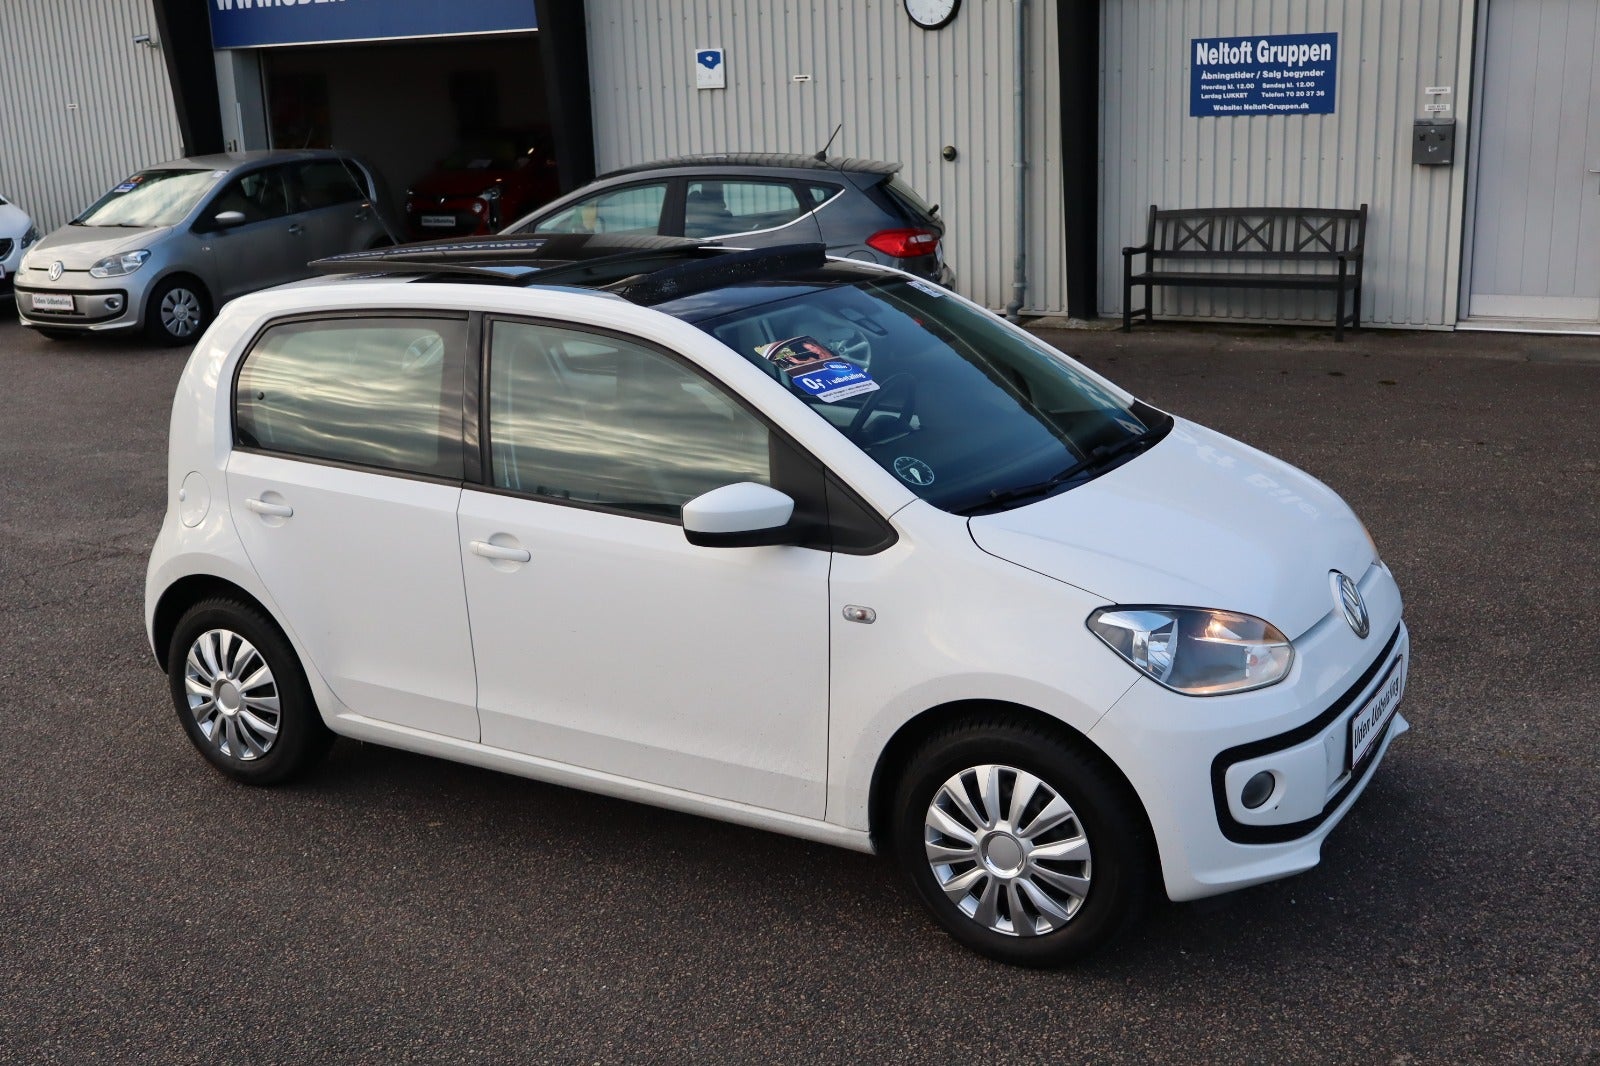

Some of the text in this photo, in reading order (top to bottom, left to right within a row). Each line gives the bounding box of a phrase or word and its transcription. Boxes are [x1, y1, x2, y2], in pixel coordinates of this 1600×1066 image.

[1196, 40, 1331, 67] Neltoft Gruppen
[1201, 70, 1255, 80] Åbningstider
[1262, 70, 1282, 79] Salg
[1283, 69, 1325, 78] begynder
[1213, 103, 1242, 111] Website:
[1354, 717, 1371, 750] Uden
